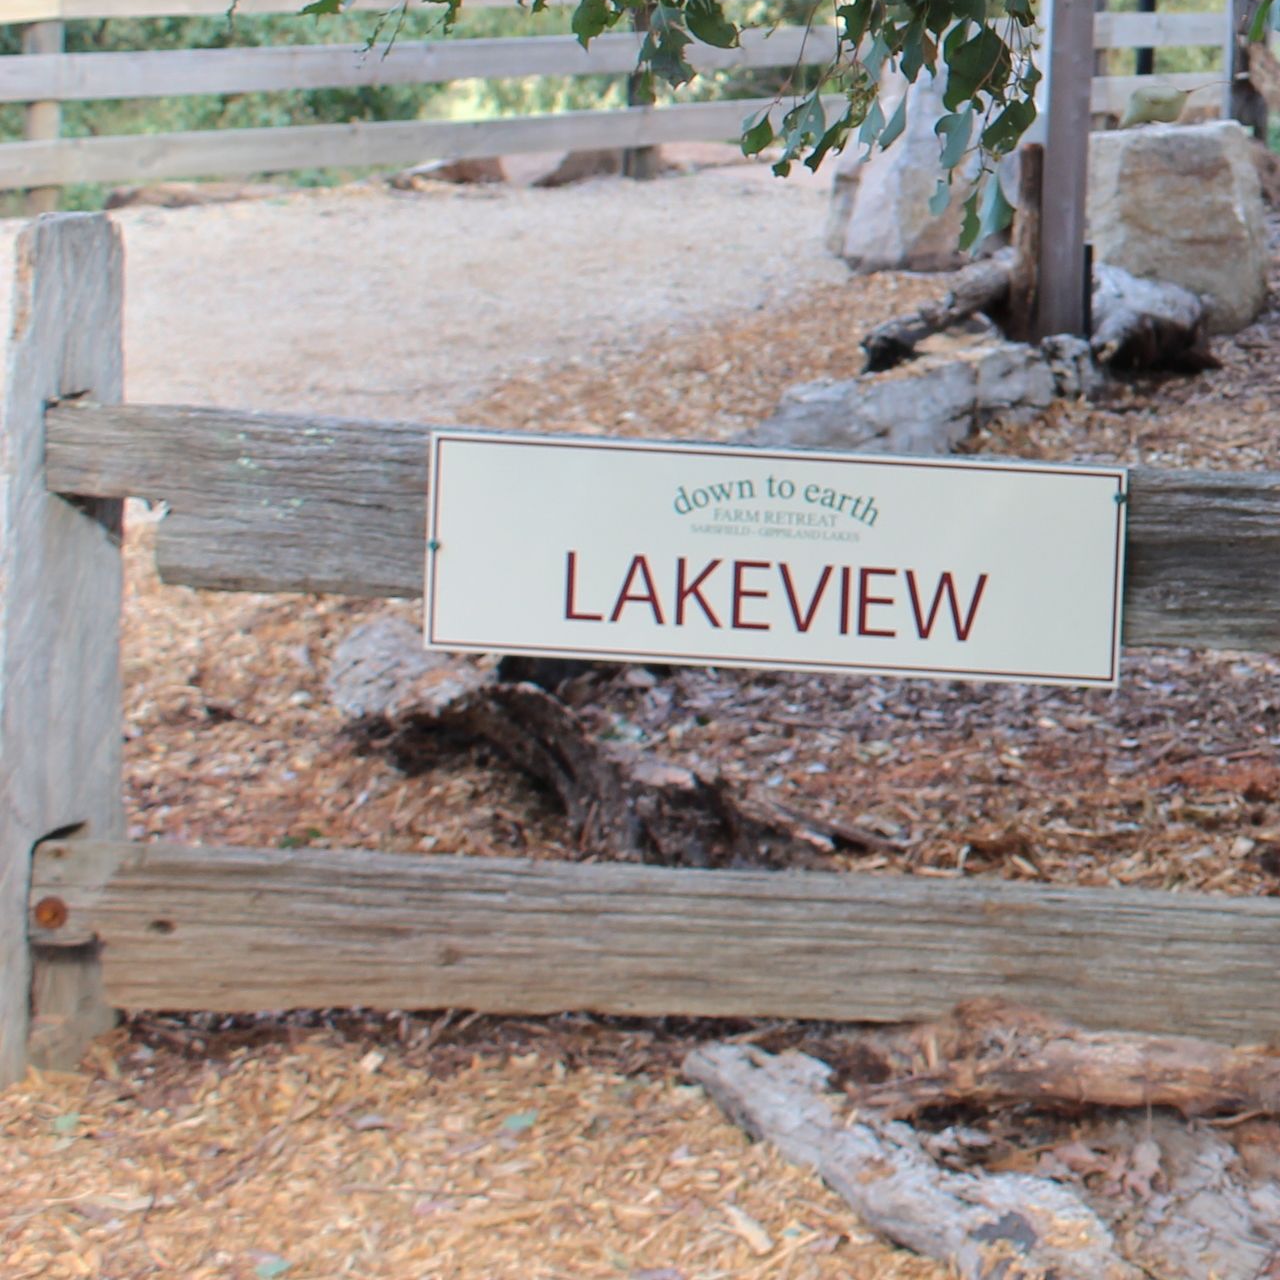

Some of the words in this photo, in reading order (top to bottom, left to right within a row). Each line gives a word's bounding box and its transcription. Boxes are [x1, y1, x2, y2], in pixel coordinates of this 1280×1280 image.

[673, 478, 756, 515] down
[767, 474, 796, 500] to
[803, 483, 879, 527] earth
[713, 507, 760, 523] FARM
[764, 510, 838, 527] RETREAT
[564, 550, 988, 641] LAKEVIEW
